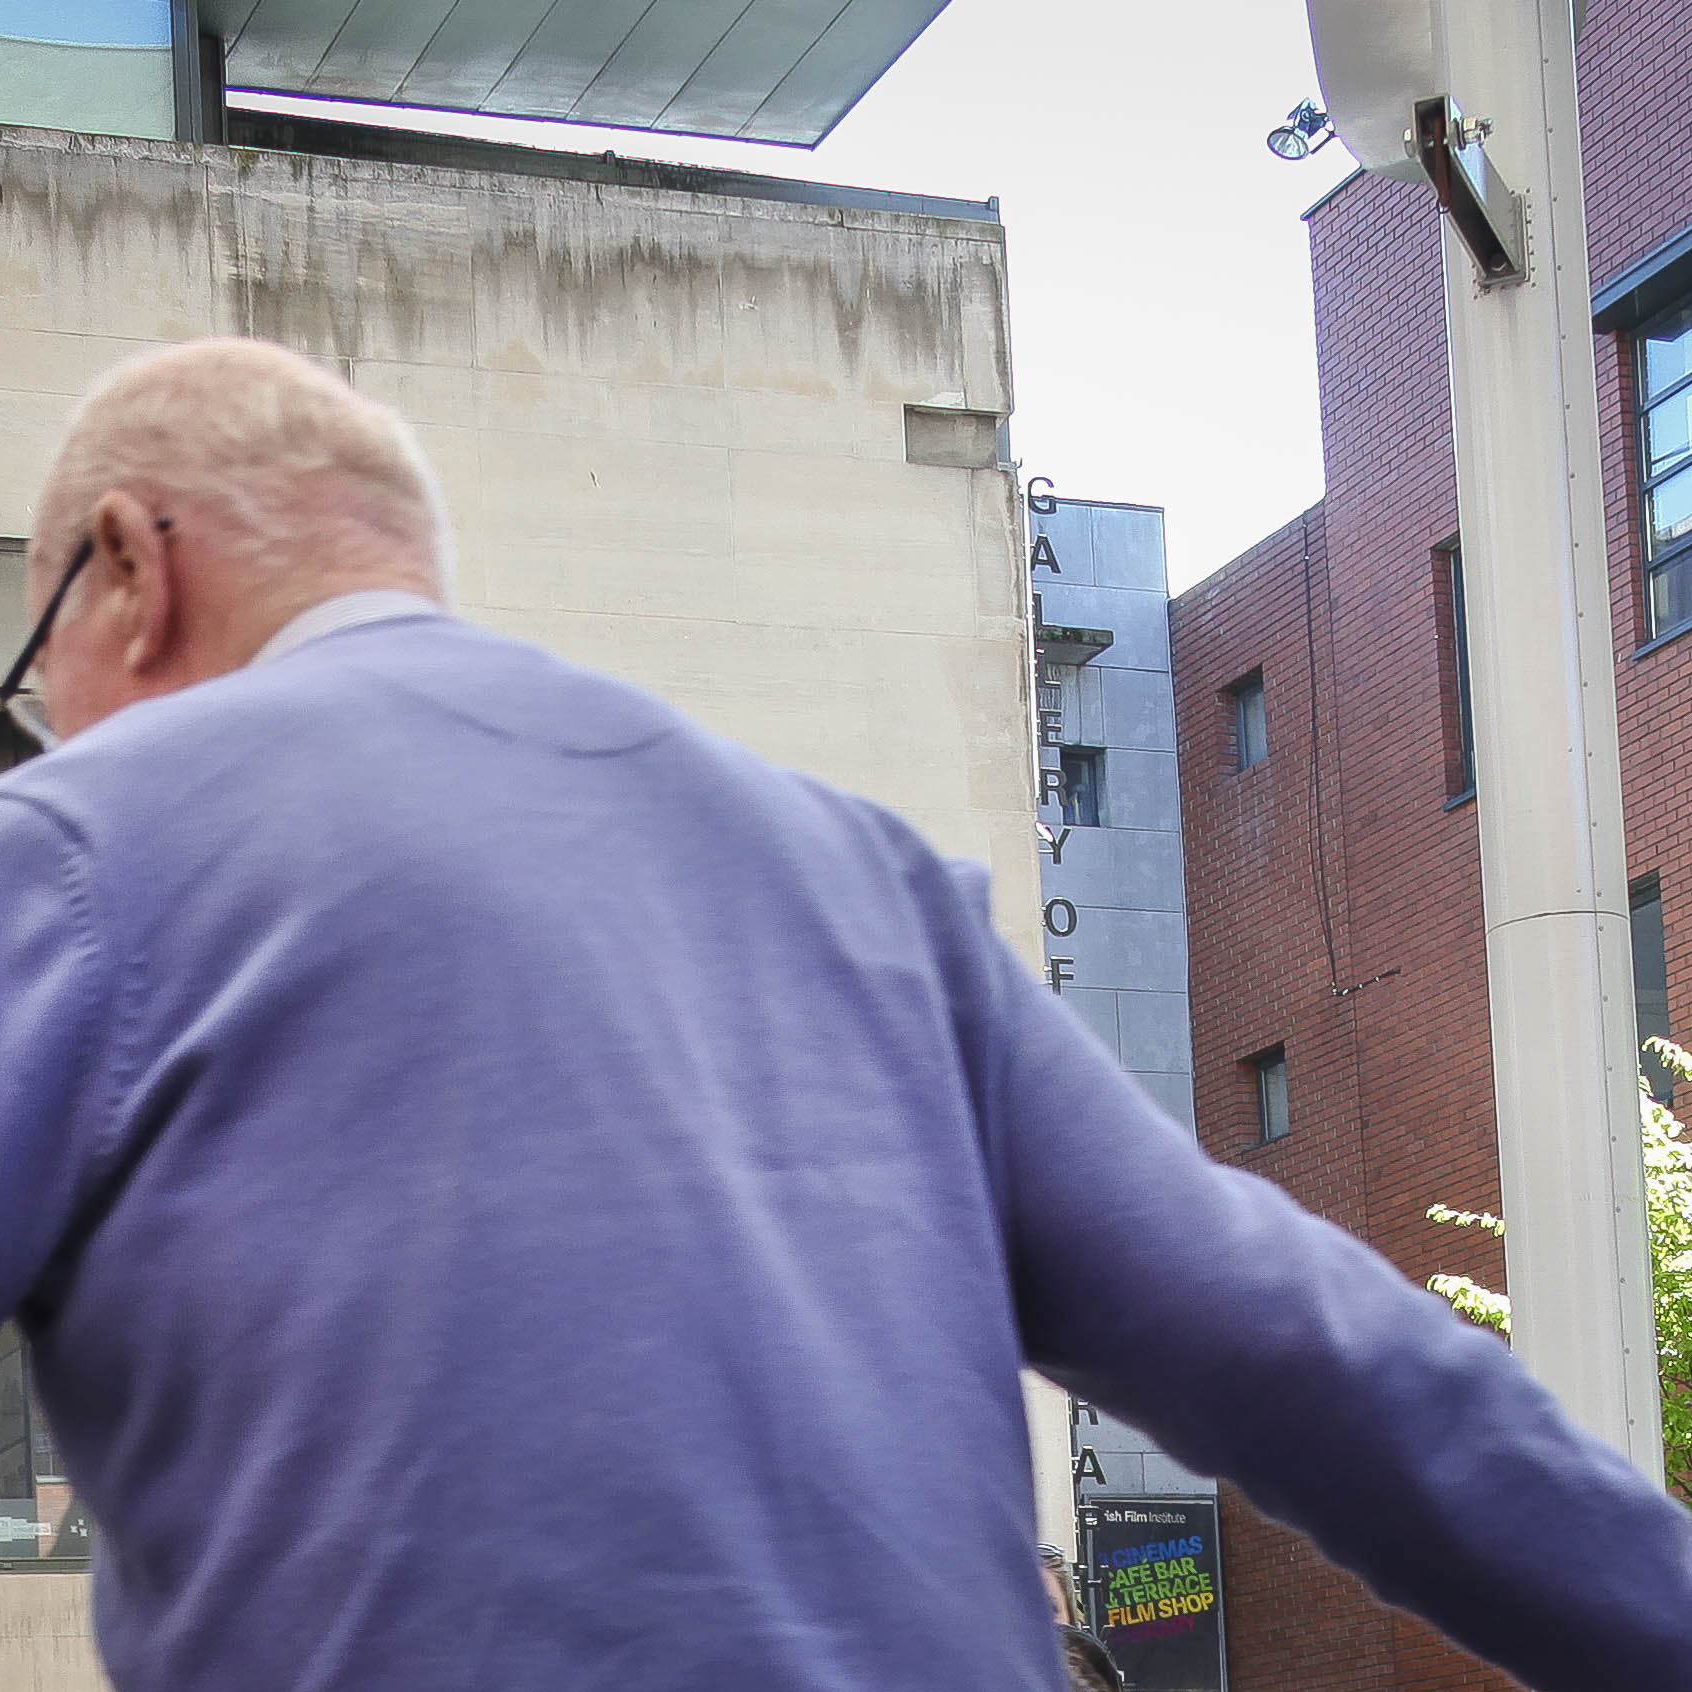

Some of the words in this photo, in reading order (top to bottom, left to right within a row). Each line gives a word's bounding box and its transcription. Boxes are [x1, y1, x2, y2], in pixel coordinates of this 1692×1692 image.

[1027, 476, 1072, 866] GALLERY
[1041, 893, 1077, 995] OF
[1124, 1511, 1148, 1523] Film
[1149, 1512, 1187, 1524] Institute
[1111, 1535, 1204, 1569] CINEMAS
[1154, 1556, 1198, 1578] BAR
[1120, 1572, 1213, 1607] TERRACE
[1107, 1602, 1156, 1627] FILM
[1158, 1592, 1214, 1618] SHOP
